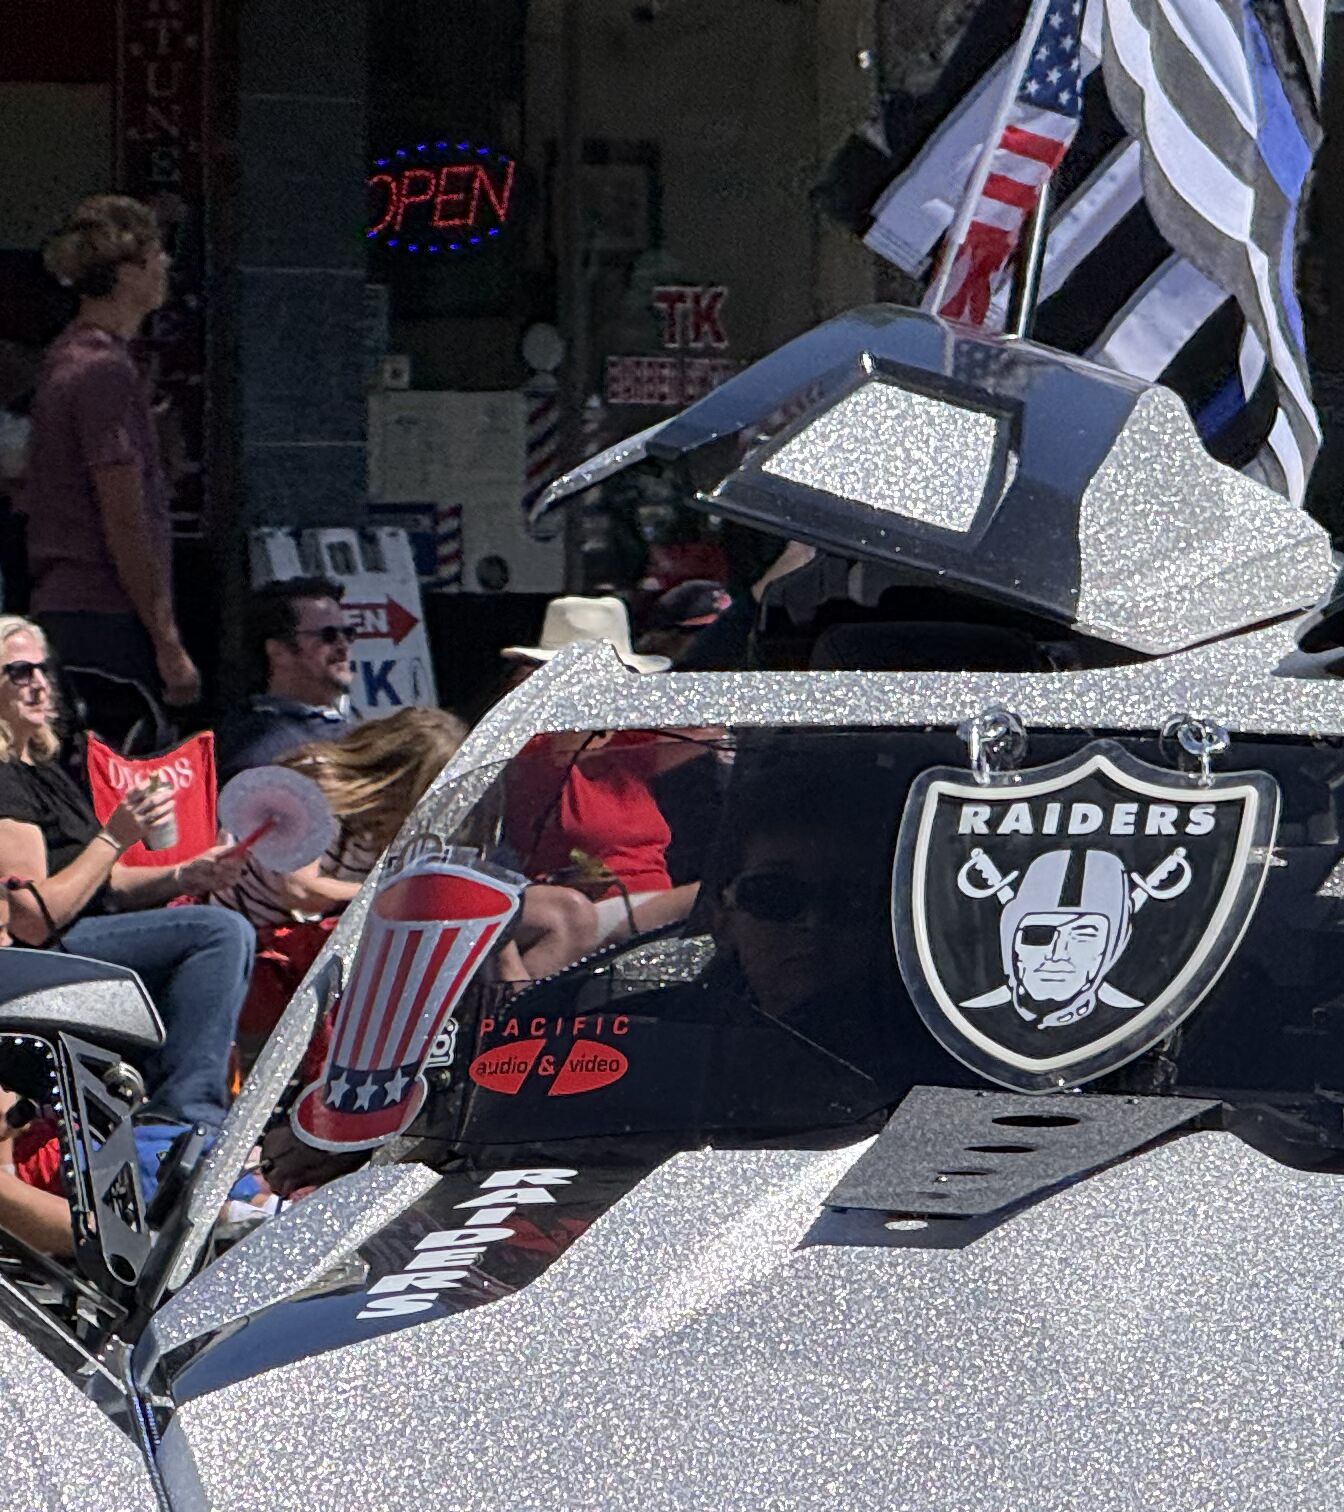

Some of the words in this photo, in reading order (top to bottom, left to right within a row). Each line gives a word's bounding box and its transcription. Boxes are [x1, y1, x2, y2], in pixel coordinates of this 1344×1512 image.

[365, 160, 517, 234] OPEN
[652, 286, 728, 349] TK
[958, 802, 1218, 837] RAIDERS
[479, 1015, 631, 1037] PACIFIC
[476, 1056, 529, 1076] audio
[538, 1054, 555, 1076] &
[568, 1054, 621, 1073] video
[357, 1168, 579, 1320] RAIDERS
